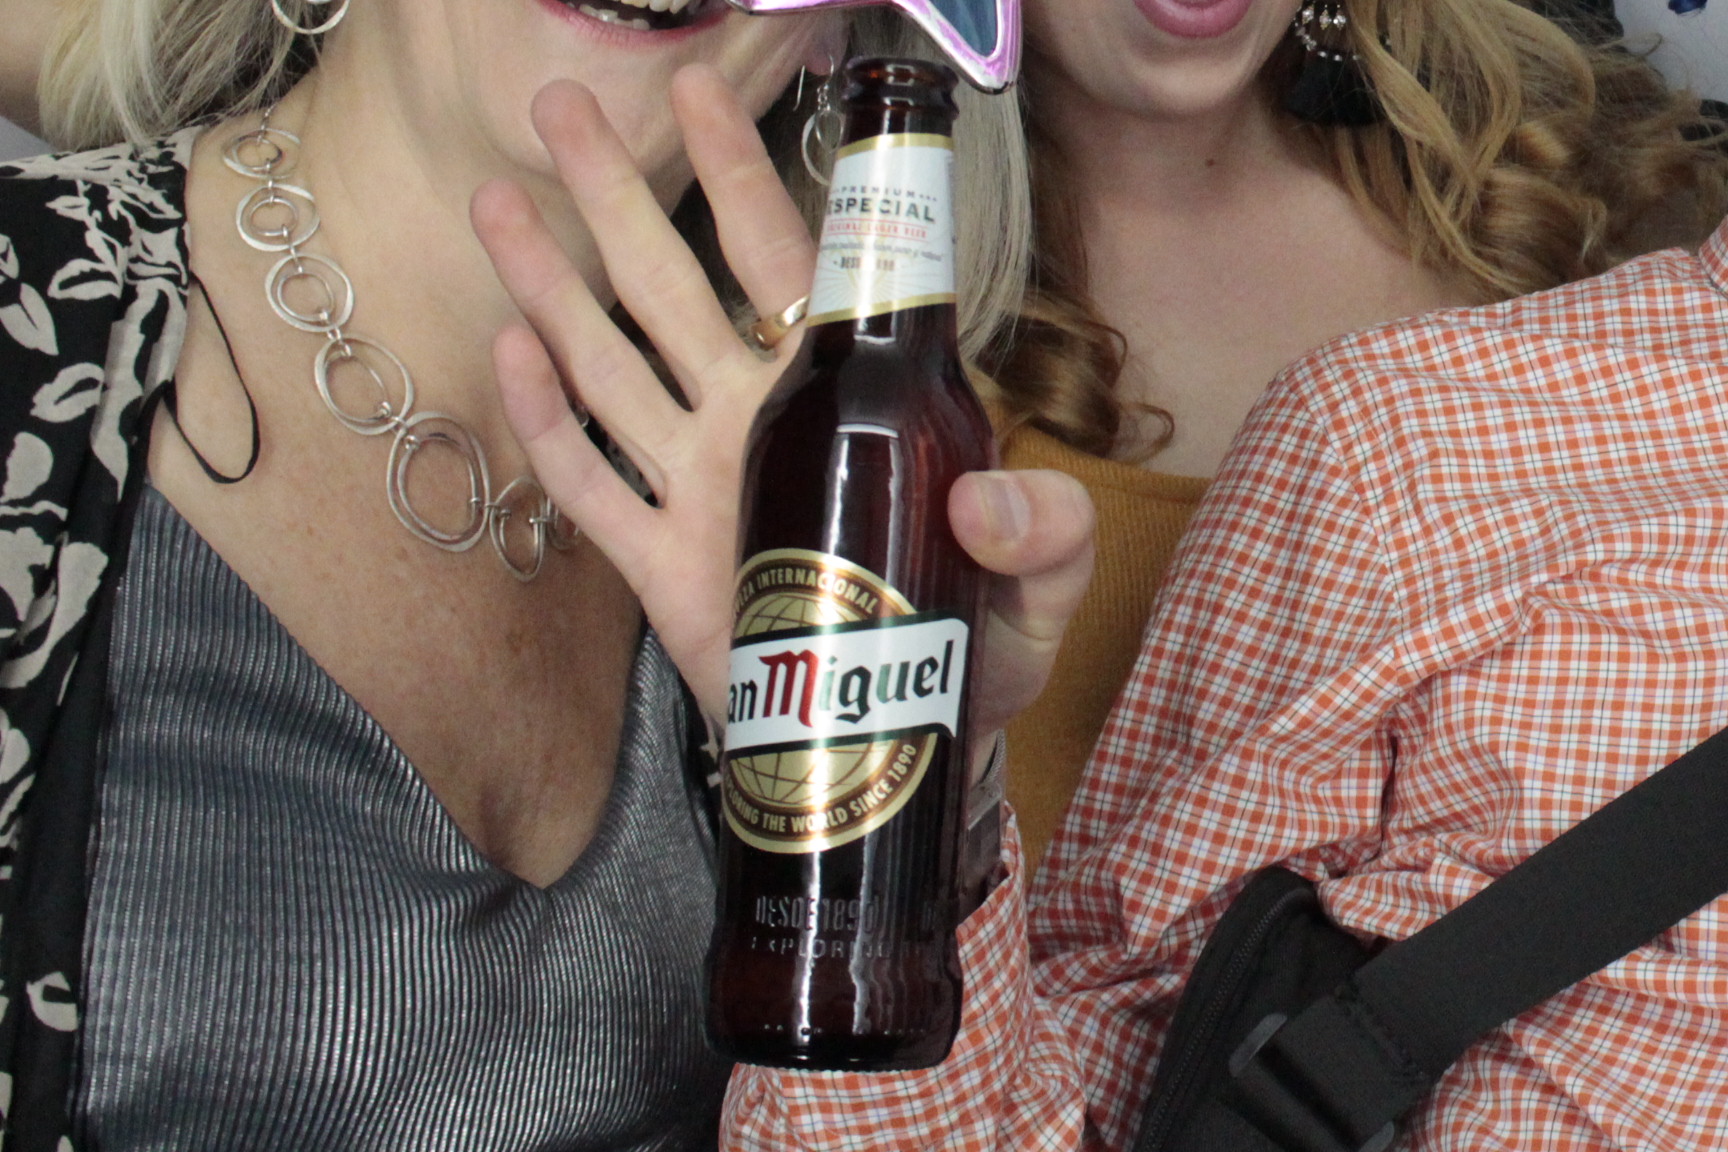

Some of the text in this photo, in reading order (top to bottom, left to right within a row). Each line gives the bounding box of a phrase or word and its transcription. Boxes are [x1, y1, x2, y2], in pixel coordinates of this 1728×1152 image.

[841, 185, 916, 199] PREMIUM
[756, 567, 879, 614] INTERNACIONAL
[727, 639, 954, 728] an Miguel
[763, 812, 787, 833] THE
[791, 807, 848, 833] WORLD
[849, 778, 893, 817] SINCE
[887, 743, 917, 782] 1890
